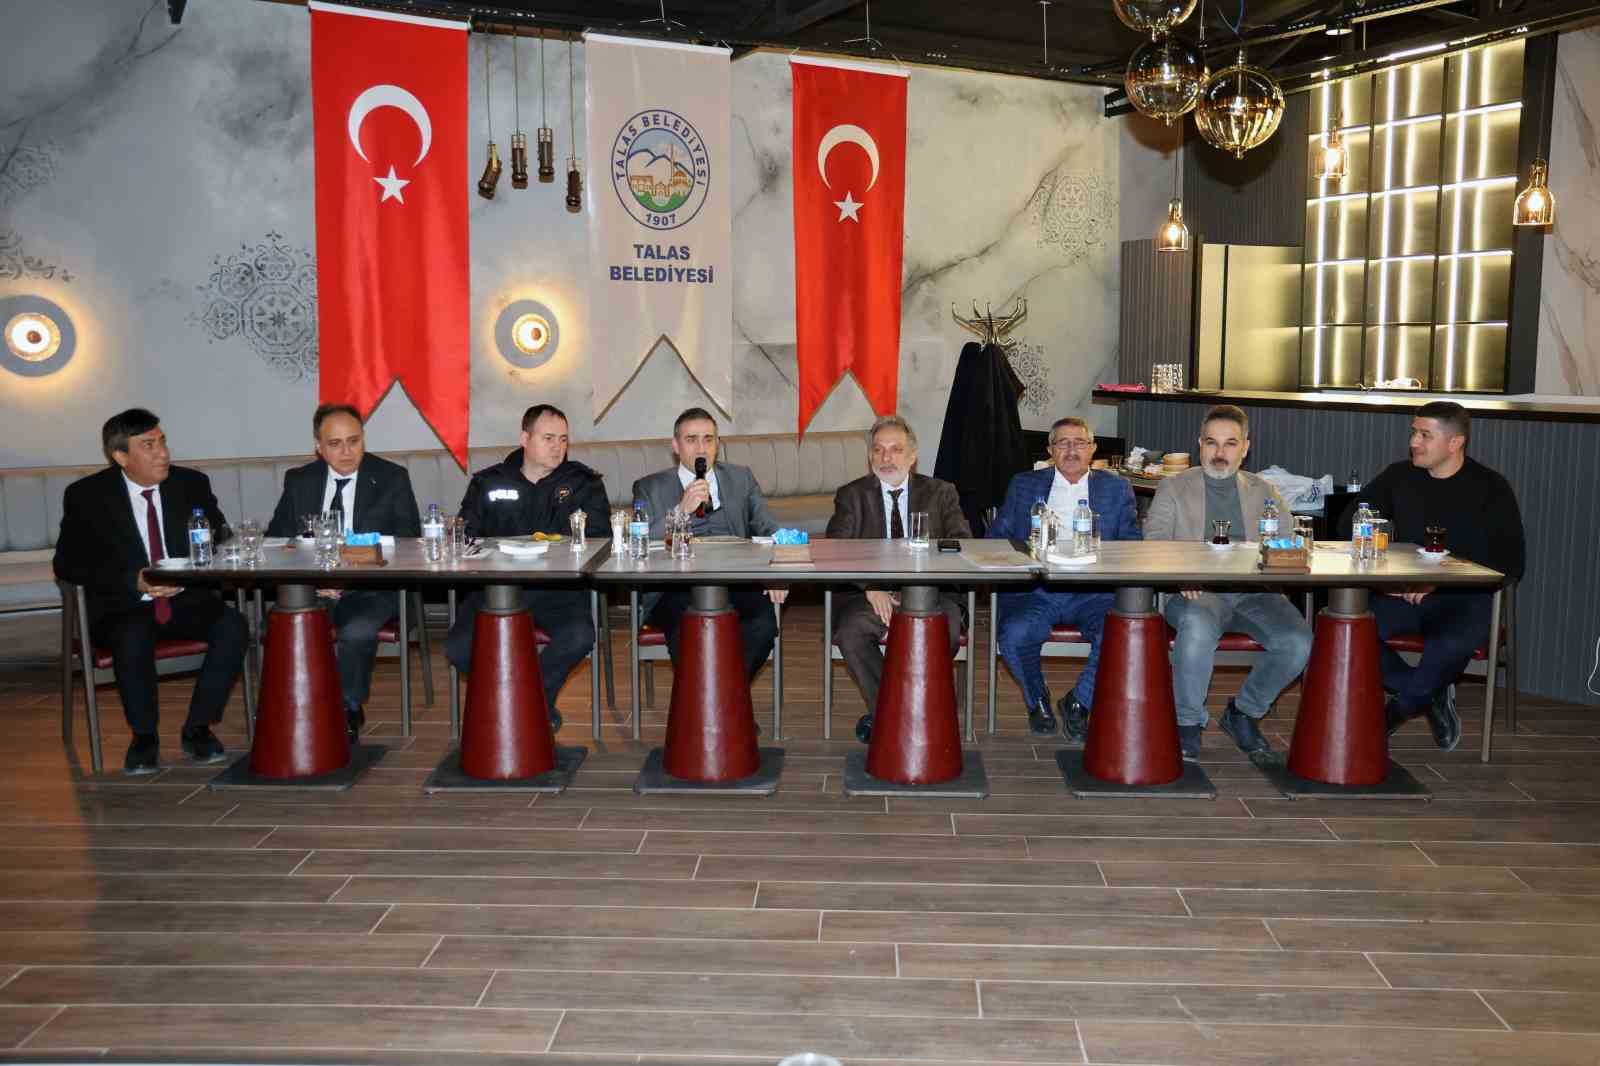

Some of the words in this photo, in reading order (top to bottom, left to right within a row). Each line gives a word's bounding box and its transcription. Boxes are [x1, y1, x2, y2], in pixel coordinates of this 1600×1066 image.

[616, 126, 638, 180] TALAS
[645, 213, 676, 226] 1907
[633, 244, 690, 260] TALAS
[609, 264, 714, 284] BELEDİYESİ
